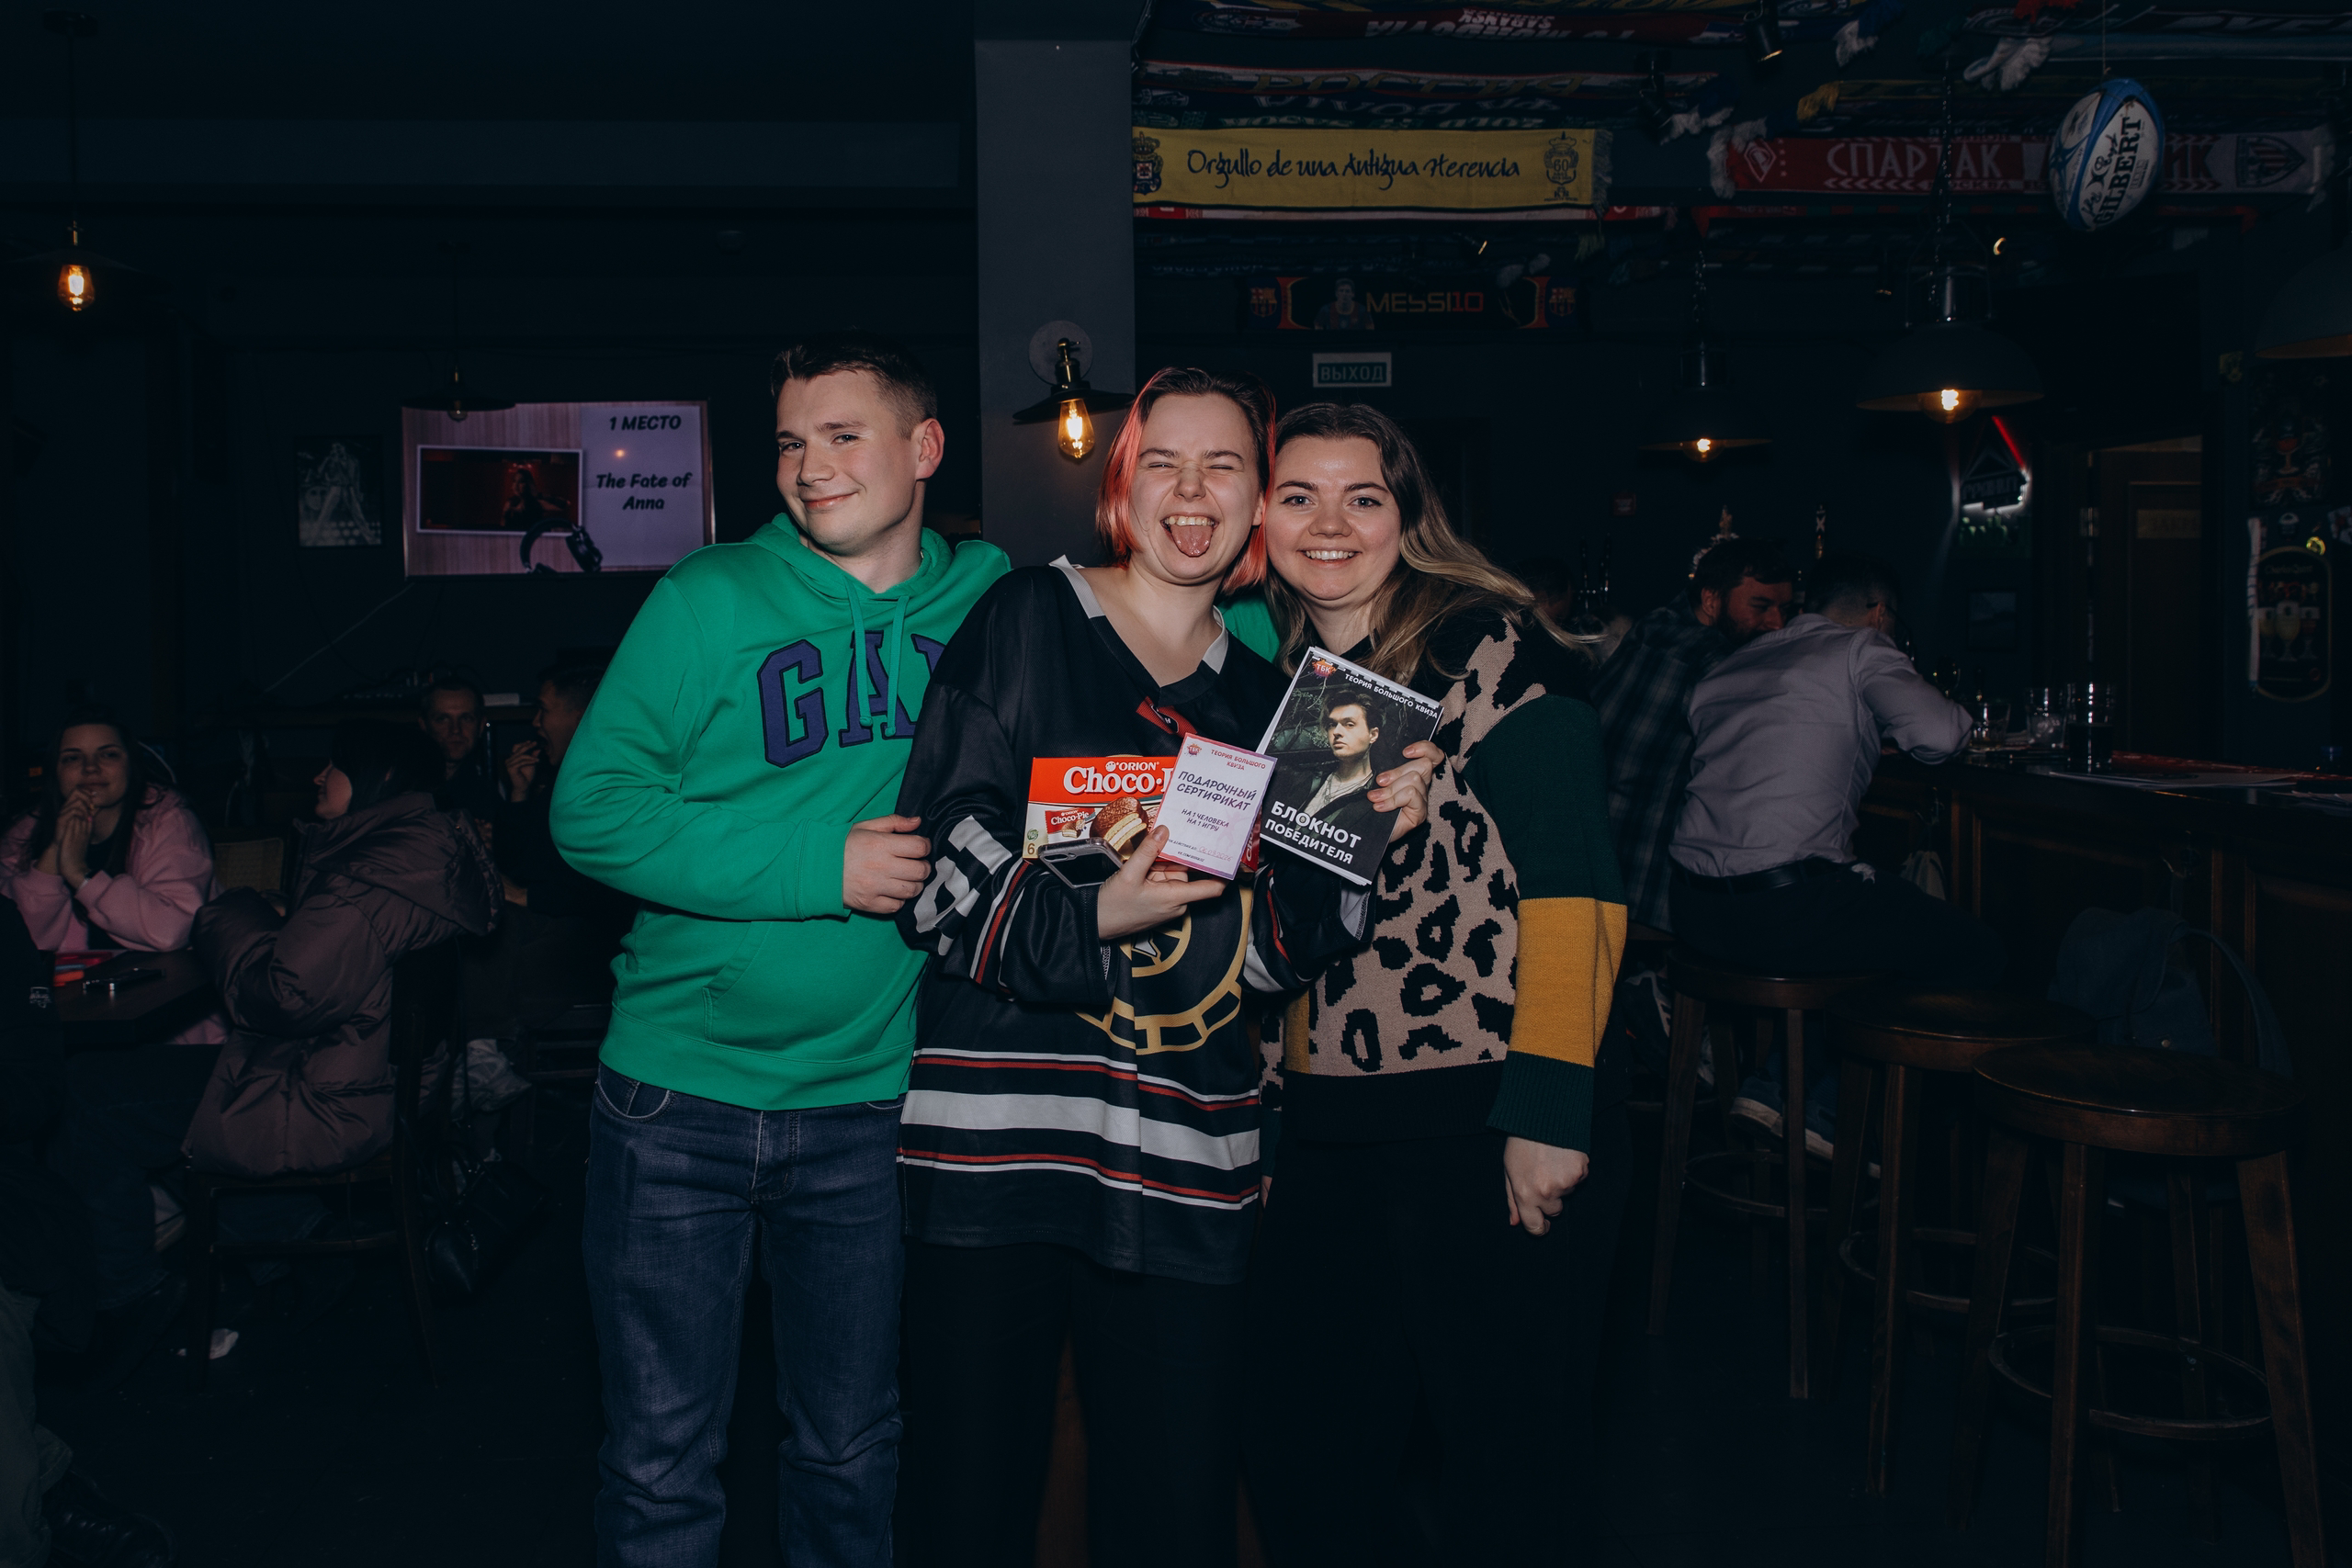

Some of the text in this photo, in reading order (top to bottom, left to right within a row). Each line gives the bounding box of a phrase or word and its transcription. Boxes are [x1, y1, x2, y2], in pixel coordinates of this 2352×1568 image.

[1187, 148, 1521, 190] Orgullo de una Antigua Herencia
[2094, 116, 2143, 226] GILBERT
[1319, 365, 1385, 384] ВЫХОД
[609, 415, 682, 430] 1 МЕСТО
[596, 473, 625, 488] The
[673, 472, 693, 488] of
[622, 496, 664, 510] Anna
[1317, 664, 1330, 672] ТБК
[757, 630, 947, 768] GA
[1345, 673, 1438, 719] ТЕОРИЯ БОЛЬШОГО КВИЗА
[1118, 761, 1157, 771] ORION
[1211, 749, 1266, 770] ТЕОРИЯ БОЛЬШОГО
[1227, 761, 1245, 771] КВИЗА
[1178, 771, 1258, 801] ПОДАРОЧНЫЙ
[1177, 783, 1250, 811] СЕРТИФИКАТ
[1182, 808, 1192, 817] НА
[1196, 814, 1229, 828] ЧЕЛОВЕКА
[1202, 822, 1220, 832] ИГРУ
[1271, 800, 1362, 849] БЛОКНОТ
[1027, 842, 1035, 855] 6
[1264, 818, 1353, 864] ПОБЕДИТЕЛЯ
